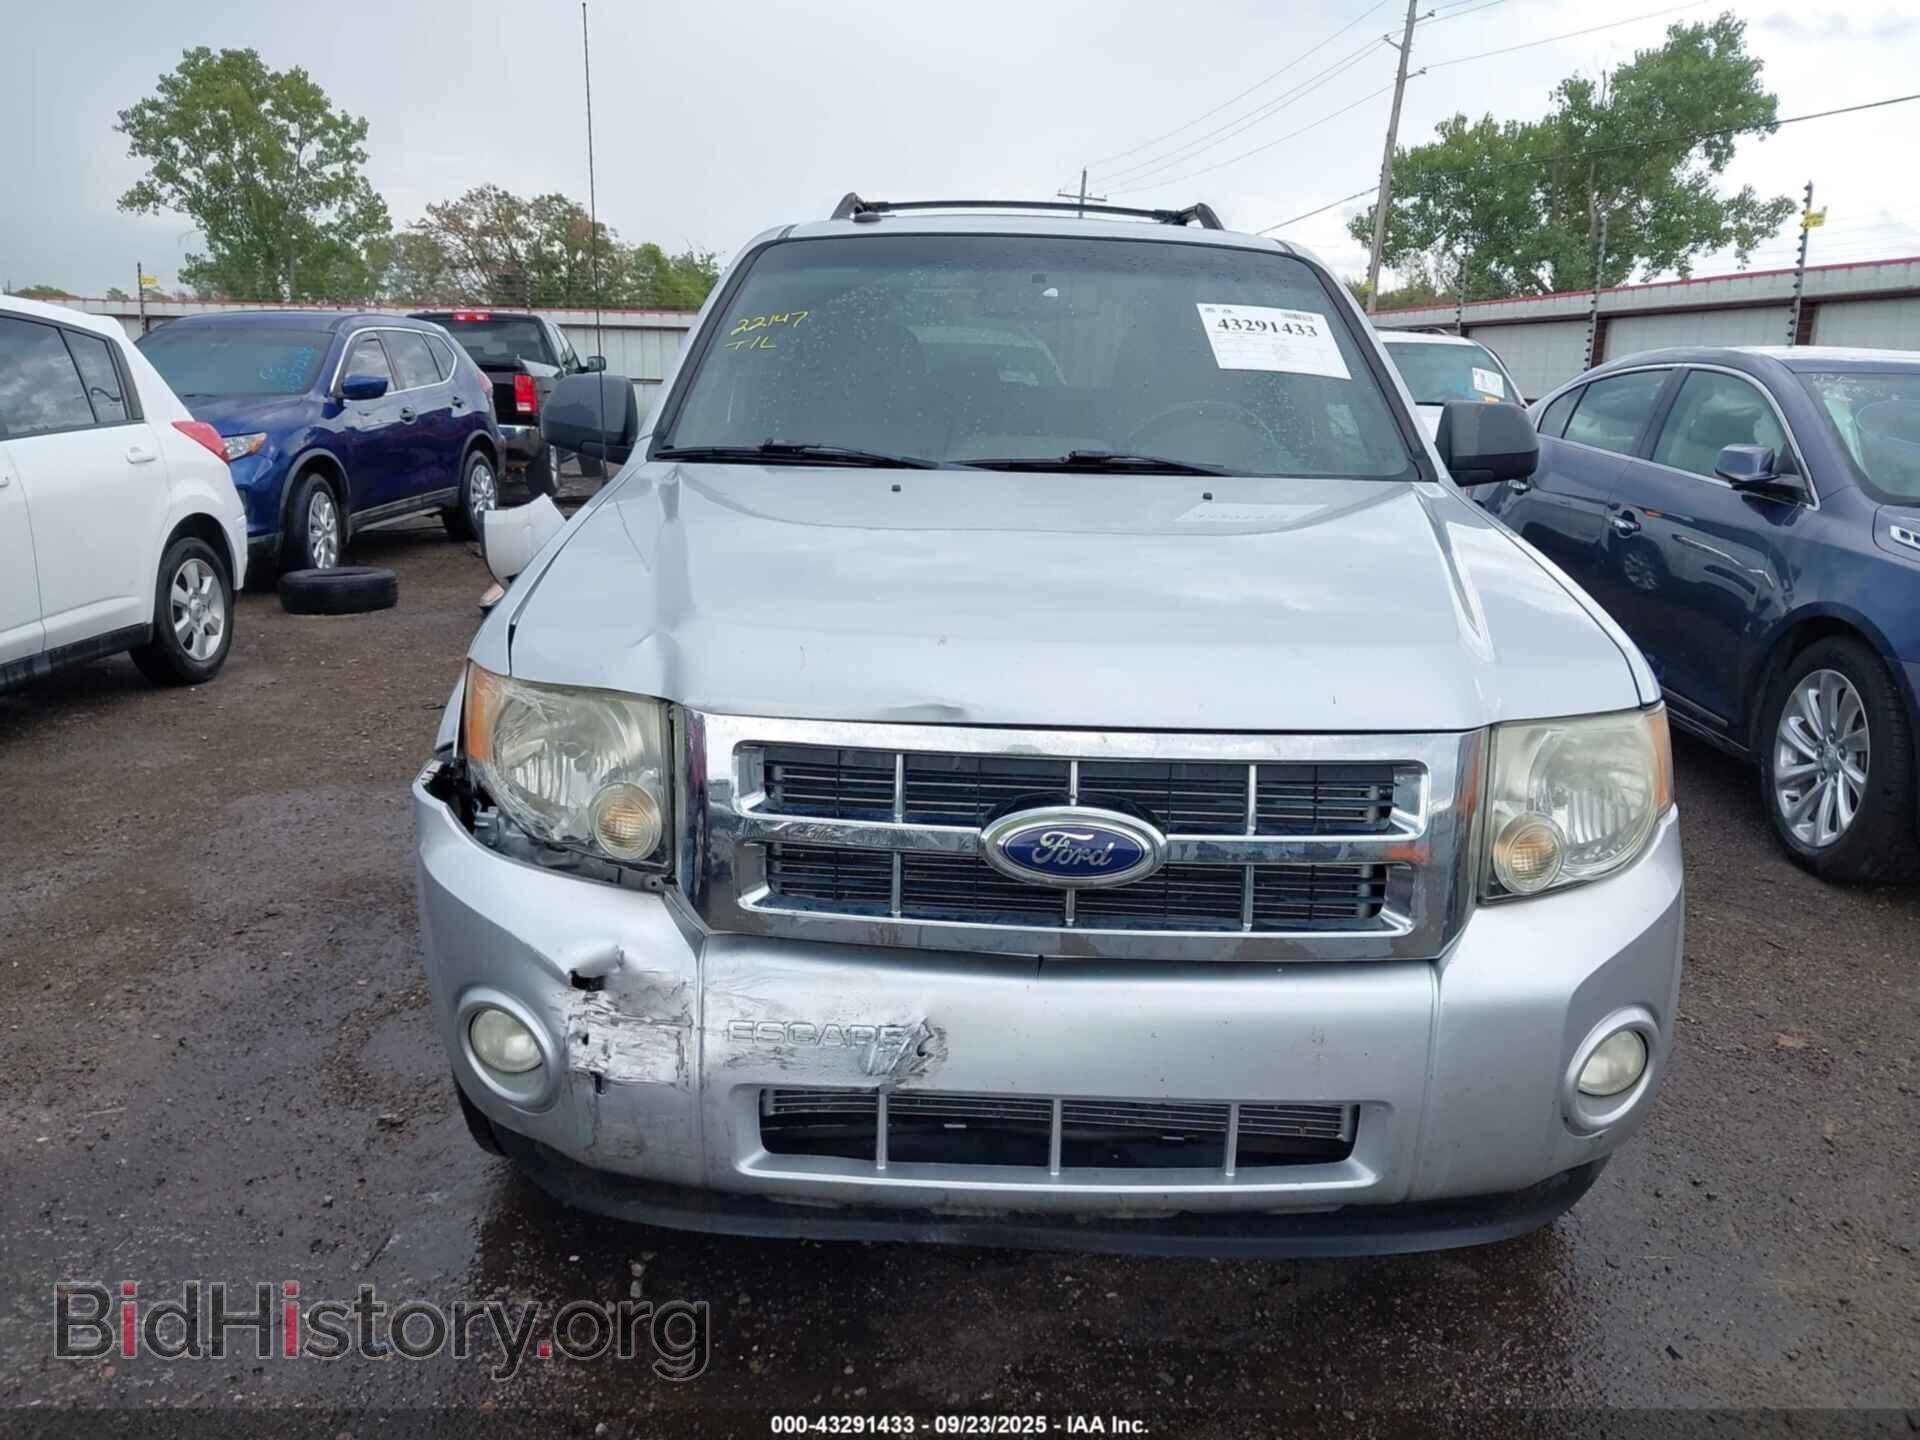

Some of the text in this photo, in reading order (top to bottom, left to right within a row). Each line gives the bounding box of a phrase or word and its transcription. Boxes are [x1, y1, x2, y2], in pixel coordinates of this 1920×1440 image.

[1217, 318, 1319, 337] 43291433
[1031, 830, 1115, 866] Ford
[728, 1019, 906, 1049] ESCAPE
